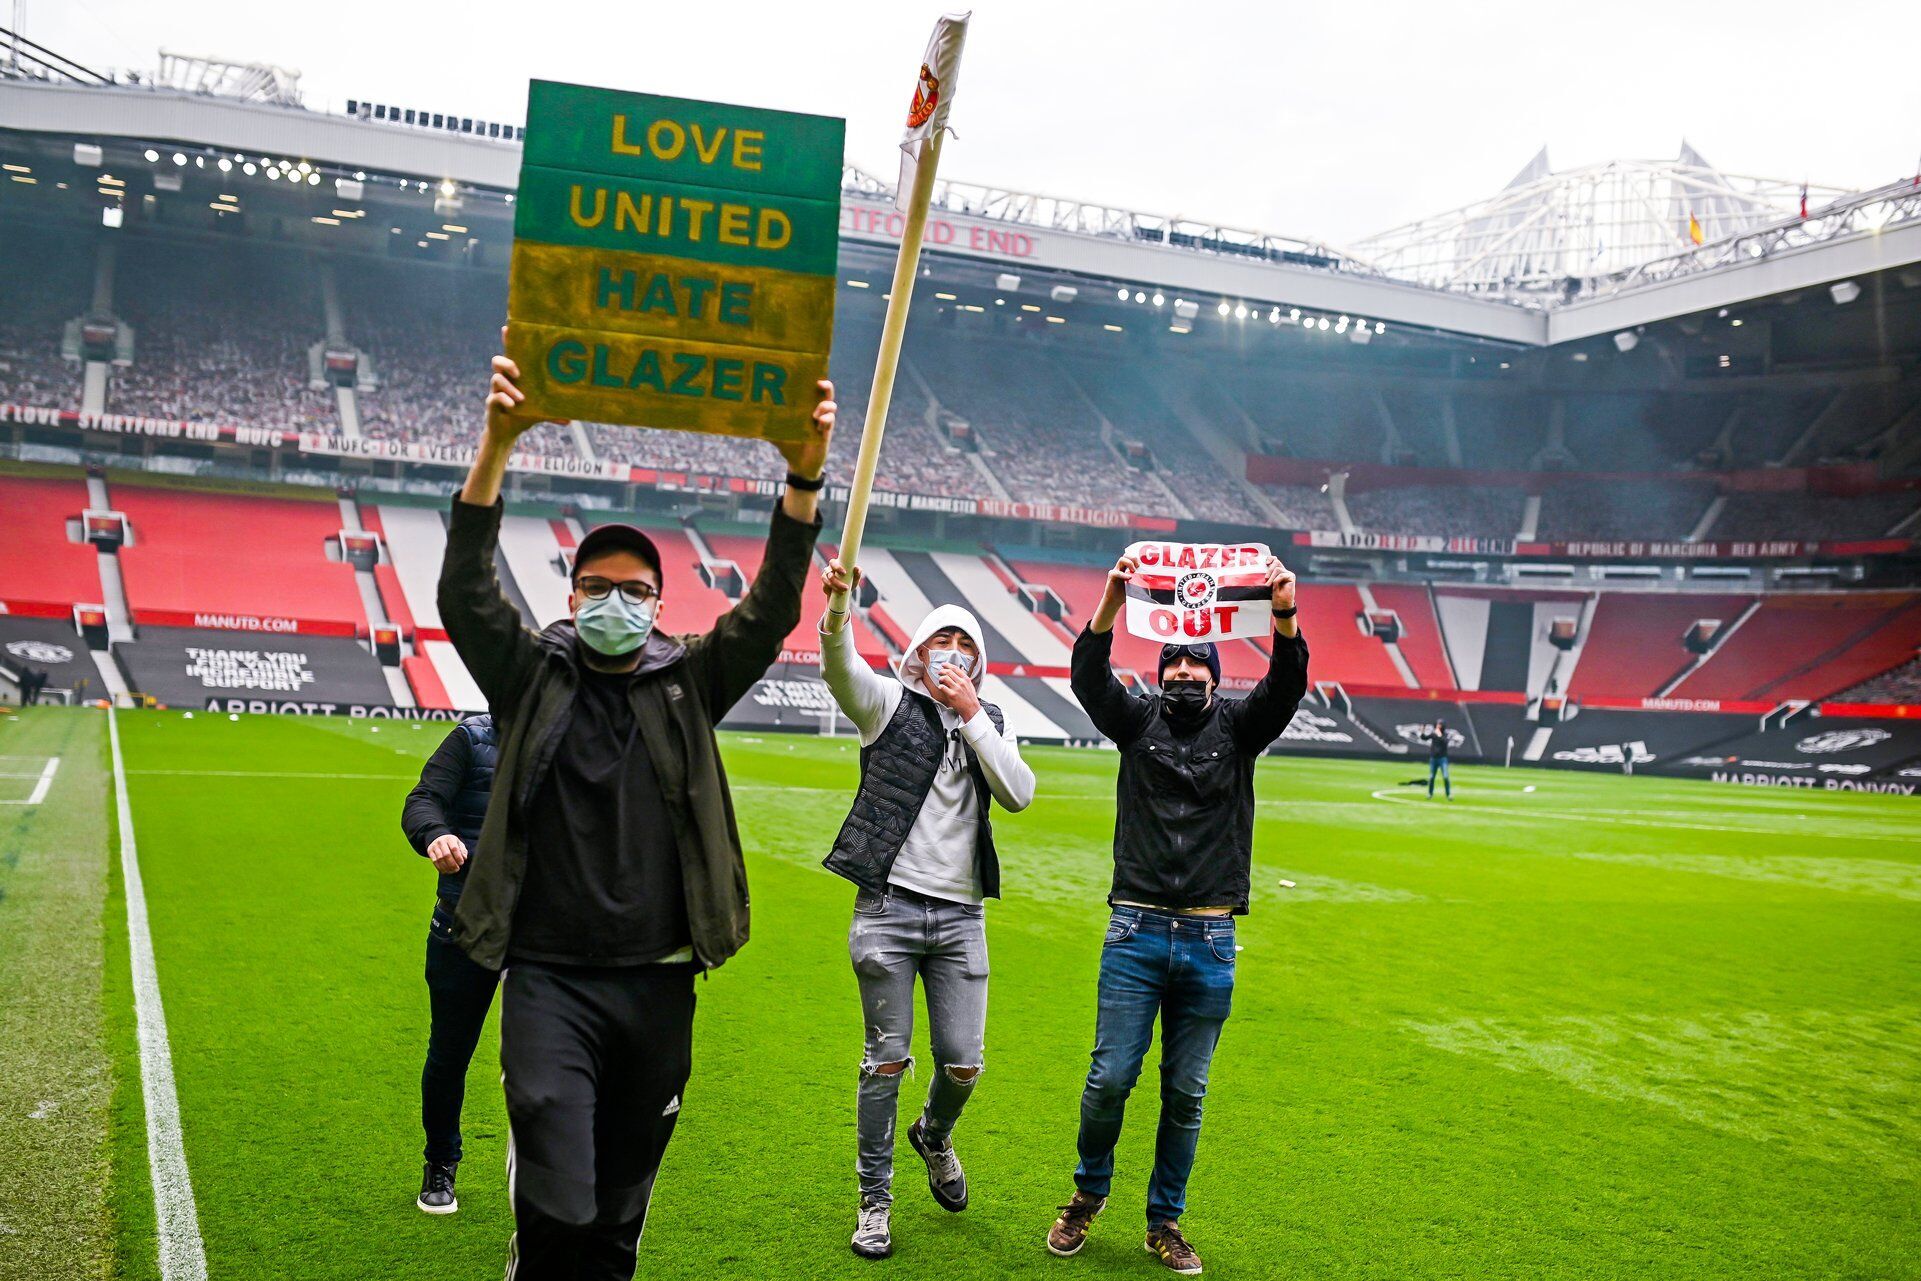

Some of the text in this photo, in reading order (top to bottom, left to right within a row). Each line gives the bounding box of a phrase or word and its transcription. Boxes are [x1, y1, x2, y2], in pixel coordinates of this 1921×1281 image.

[611, 114, 764, 172] LOVE
[569, 184, 793, 250] UNITED
[970, 225, 1033, 257] END
[595, 266, 756, 327] HATE
[546, 339, 789, 406] GLAZER
[14, 405, 60, 427] LOVE
[78, 412, 181, 437] STRETFORD
[185, 420, 219, 441] END
[235, 426, 282, 447] MUFC
[1060, 506, 1129, 527] RELIGION
[1139, 544, 1259, 569] GLAZER
[194, 613, 298, 632] MANUTD.COM
[1149, 605, 1239, 637] OUT
[185, 648, 308, 664] THANK YOU
[1641, 698, 1720, 711] MANUTD.COM
